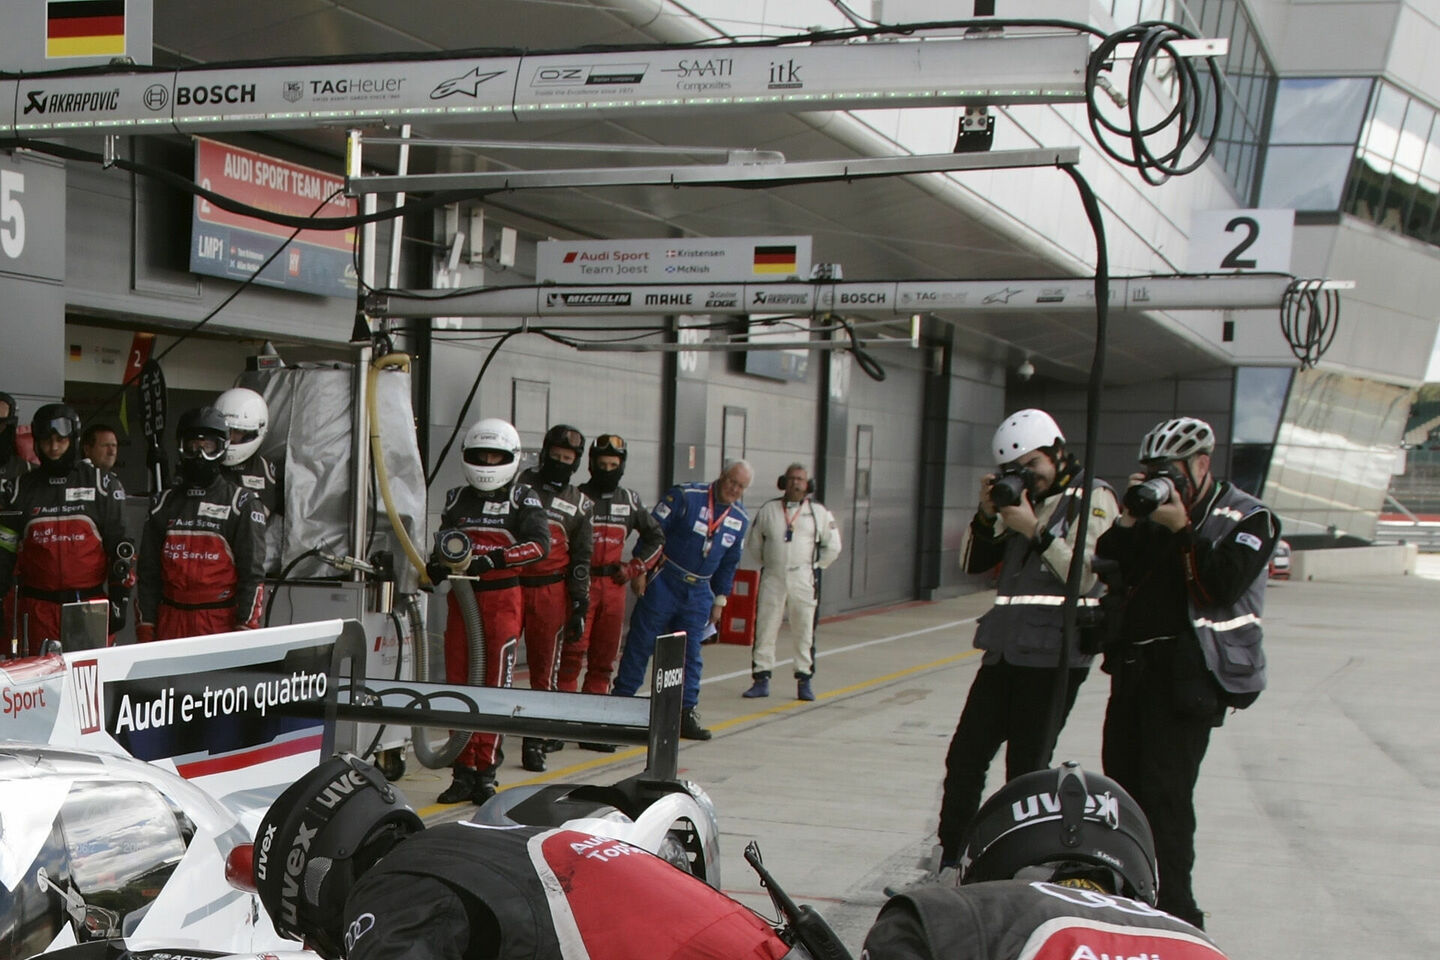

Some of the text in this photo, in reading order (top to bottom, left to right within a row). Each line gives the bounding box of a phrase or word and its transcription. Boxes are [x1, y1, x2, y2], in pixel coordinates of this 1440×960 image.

[540, 69, 582, 80] OZ
[677, 58, 733, 78] SAATI
[768, 59, 803, 83] itk
[176, 84, 257, 105] BOSCH
[676, 80, 732, 93] Composites
[224, 152, 253, 184] AUDI
[255, 161, 290, 194] SPORT
[291, 171, 322, 200] TEAM
[198, 235, 224, 261] LMP1
[1220, 217, 1260, 269] 2
[579, 250, 650, 264] Audi Sport
[677, 248, 726, 258] Kristensen
[580, 264, 649, 275] Team Joest
[677, 265, 710, 274] McNish
[565, 293, 630, 305] MICHELIN
[645, 293, 693, 305] MAHLE
[705, 299, 737, 308] EDGE
[840, 292, 886, 304] BOSCH
[134, 350, 141, 368] 2
[61, 503, 86, 513] Sport
[483, 517, 505, 526] Sport
[182, 552, 220, 562] Service
[2, 686, 46, 718] Sport
[73, 664, 98, 730] HY
[115, 670, 329, 735] Audi e-tron quattro
[316, 769, 373, 810] uve
[258, 823, 278, 881] uvex
[570, 836, 612, 855] Aud
[281, 821, 318, 926] uvex
